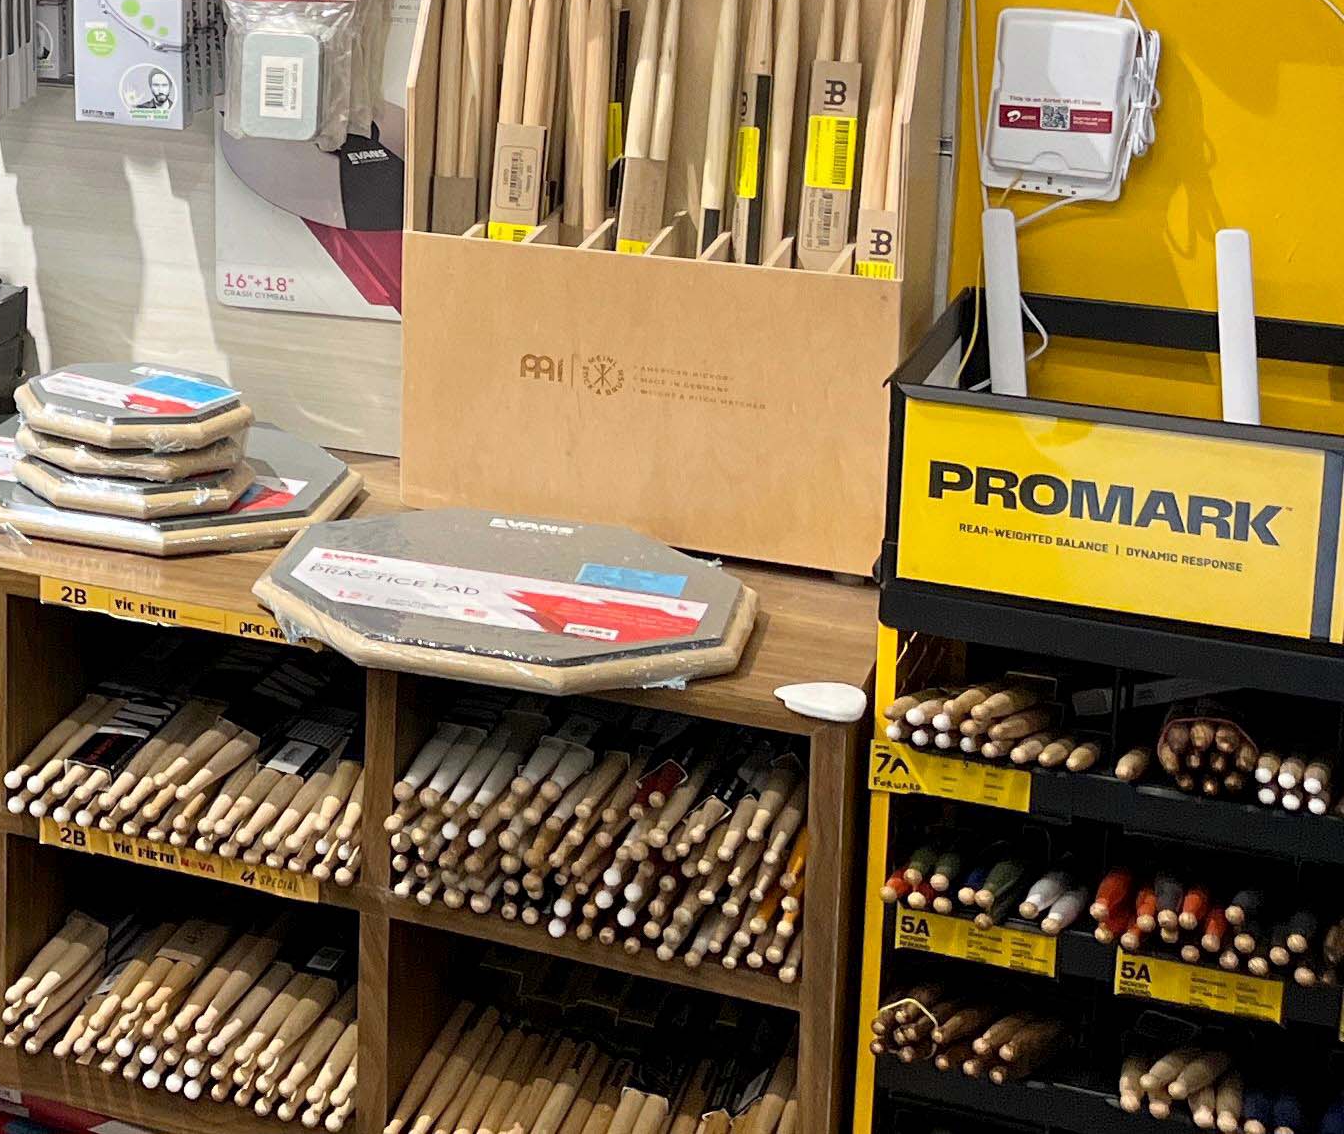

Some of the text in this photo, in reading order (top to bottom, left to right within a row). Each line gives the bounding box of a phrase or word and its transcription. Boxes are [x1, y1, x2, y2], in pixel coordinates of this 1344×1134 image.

[347, 150, 387, 163] EVANS
[224, 289, 251, 299] CRASH
[928, 460, 1281, 547] PROMARK
[488, 518, 574, 534] EVANS
[322, 552, 379, 564] EVANS
[959, 523, 1243, 572] REAR-WEIGHTED BALANCE DYNAMIC RESPONSE
[310, 565, 480, 596] PRACTICE PAD
[61, 586, 86, 605] 2B
[875, 752, 910, 776] 7A
[60, 826, 86, 848] 2B
[259, 872, 299, 892] SPECIAL
[900, 916, 930, 938] 5A
[1120, 961, 1150, 983] 5A
